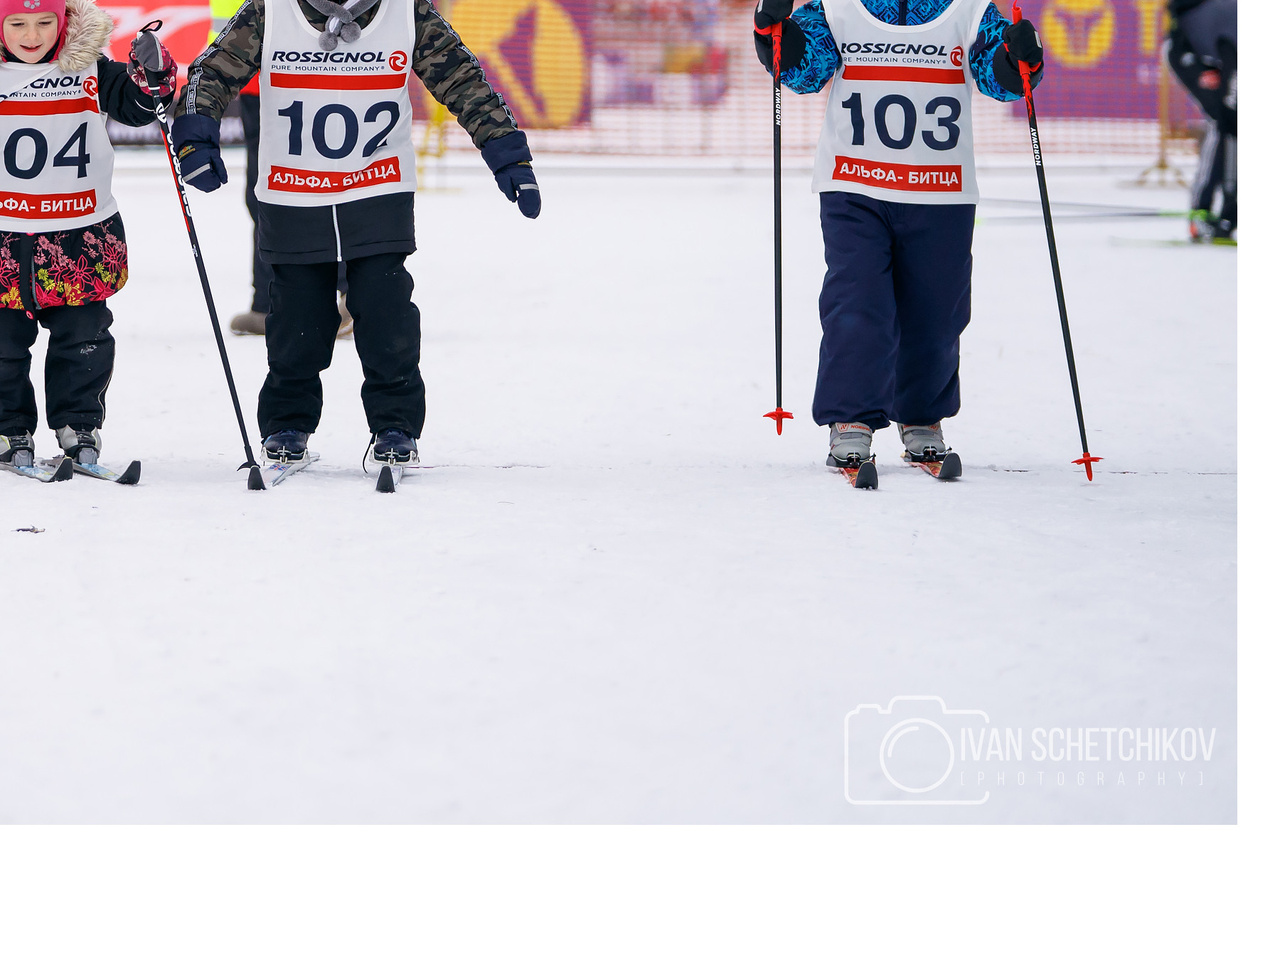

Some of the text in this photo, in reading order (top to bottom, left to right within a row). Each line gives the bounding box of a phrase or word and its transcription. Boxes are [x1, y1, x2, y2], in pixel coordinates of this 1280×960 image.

[271, 51, 386, 63] ROSSIGNOL
[277, 100, 401, 160] 102
[841, 92, 962, 151] 103
[1030, 127, 1042, 166] NORDWAY
[342, 163, 397, 187] БИТЦА
[908, 171, 959, 187] БИТЦА
[40, 196, 94, 213] БИТЦА
